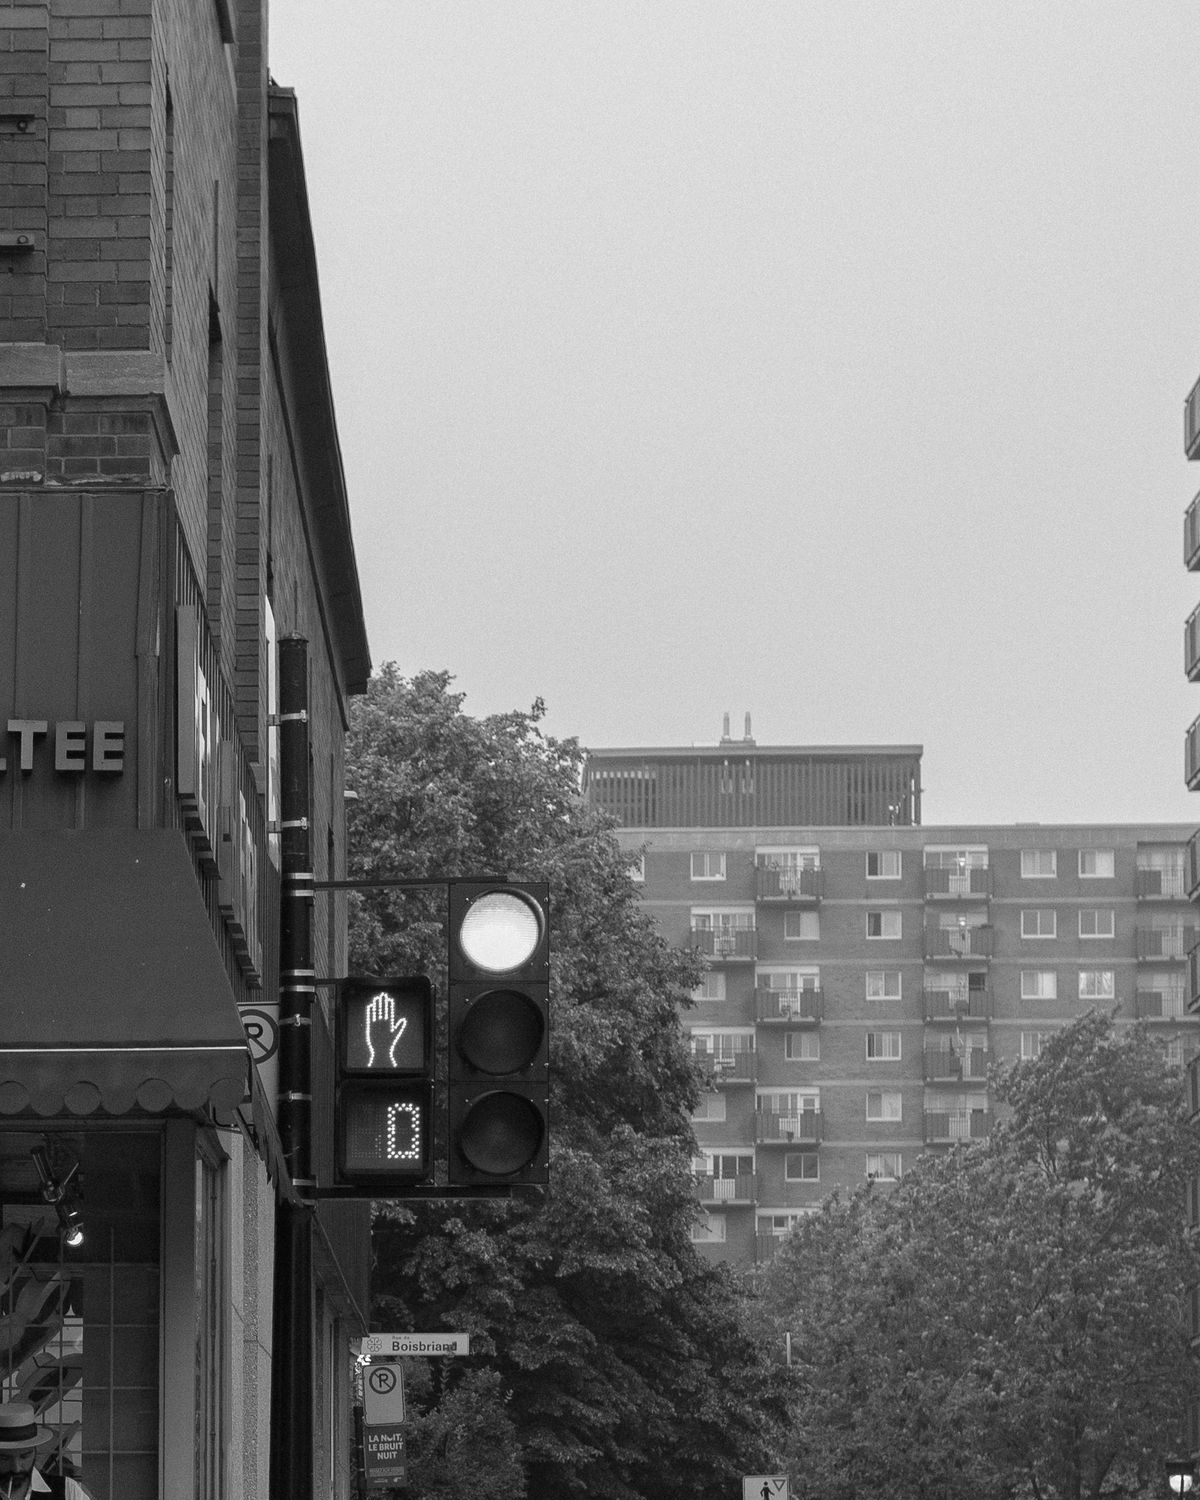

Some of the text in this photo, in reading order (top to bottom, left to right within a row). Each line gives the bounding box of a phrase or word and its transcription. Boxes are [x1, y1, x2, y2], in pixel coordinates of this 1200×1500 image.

[387, 1103, 420, 1160] 0
[392, 1341, 458, 1352] Boisbriand
[368, 1434, 380, 1443] LA
[368, 1442, 404, 1452] LE BRUIT
[377, 1451, 398, 1460] NUIT
